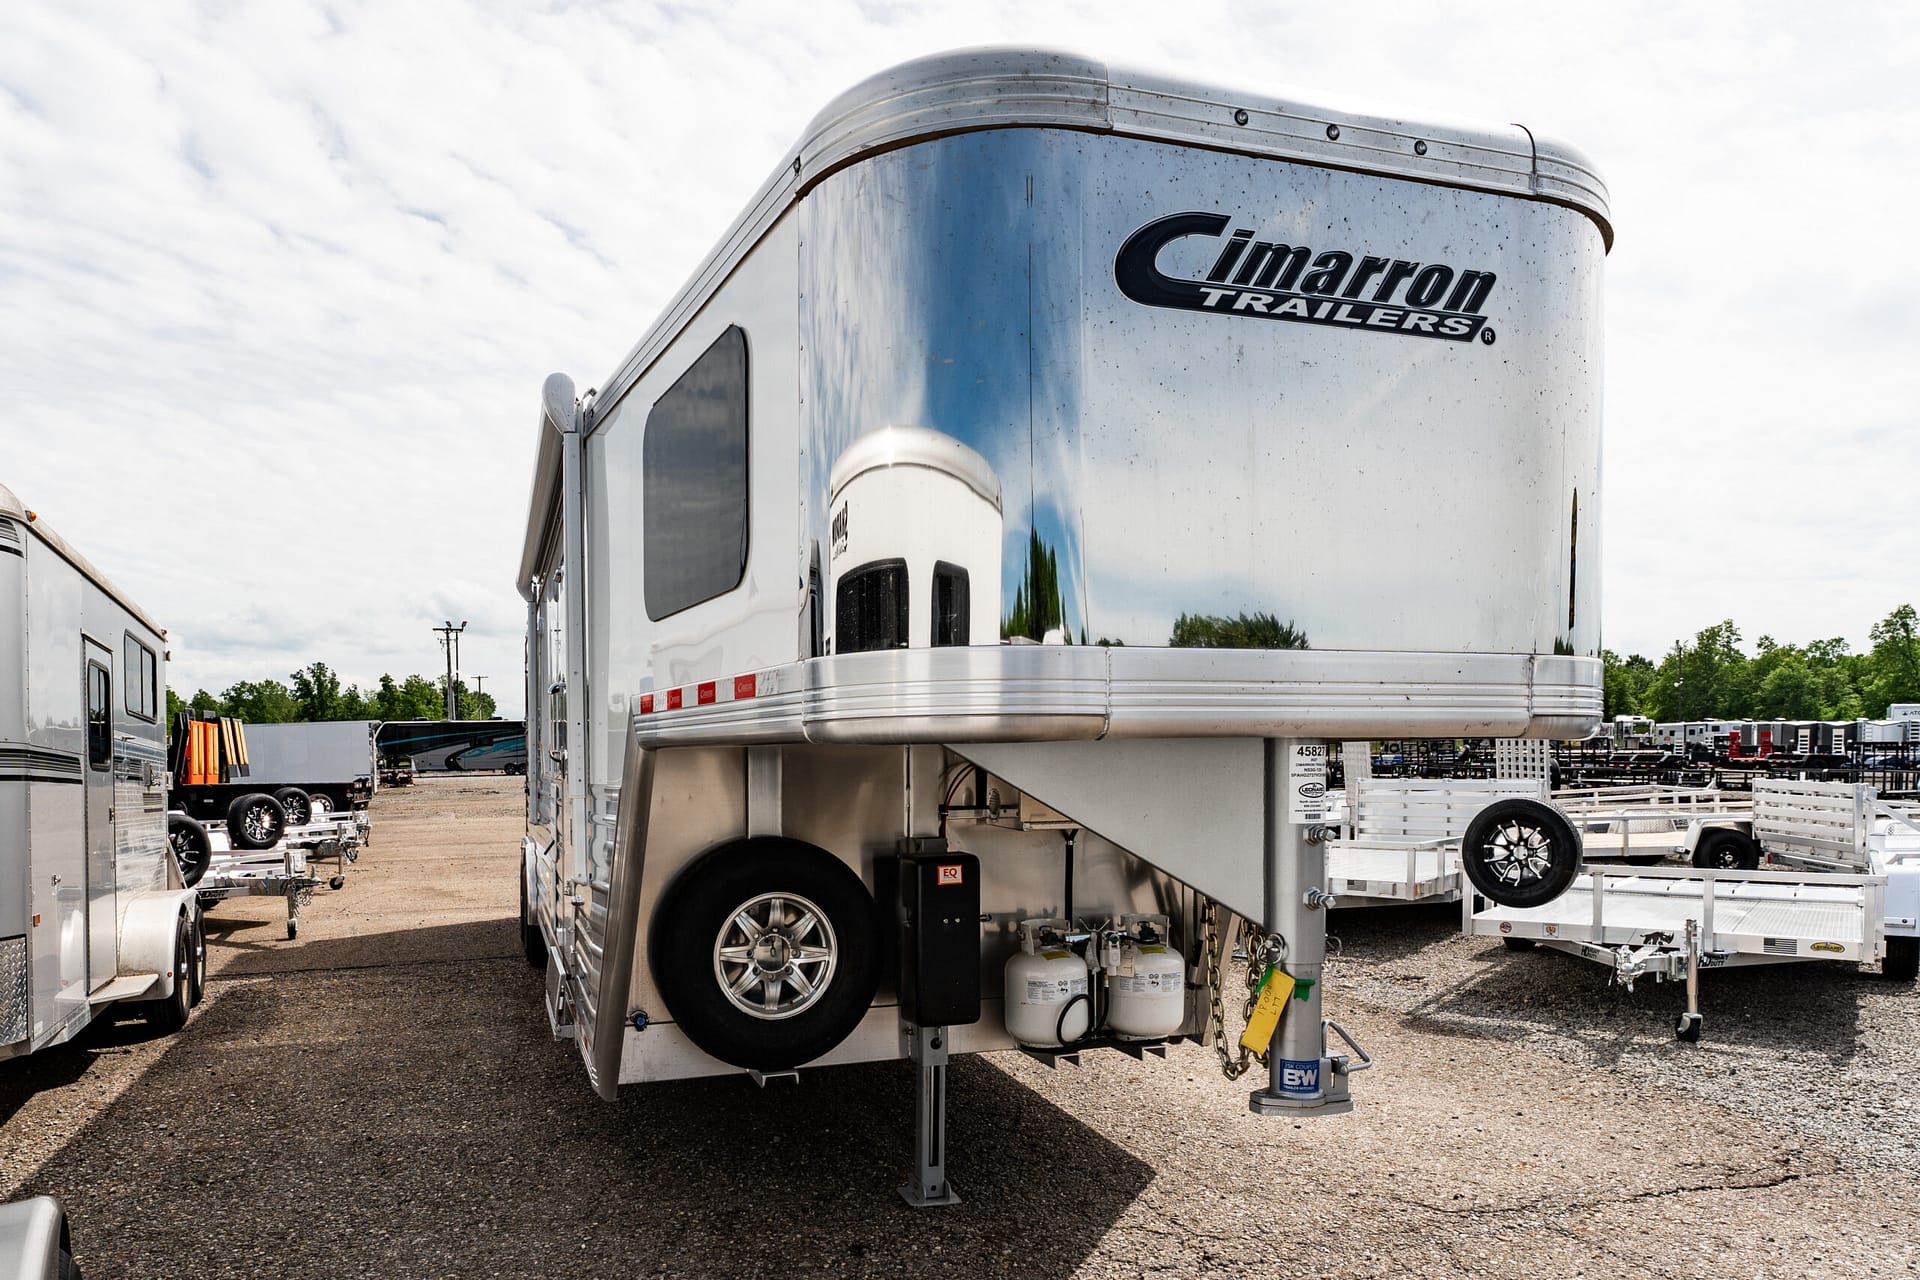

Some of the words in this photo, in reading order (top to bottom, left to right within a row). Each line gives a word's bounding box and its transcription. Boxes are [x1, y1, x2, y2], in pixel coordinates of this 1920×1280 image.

[1114, 211, 1497, 315] Cimarron
[1200, 287, 1473, 336] TRAILERS
[1297, 746, 1326, 756] 45827
[943, 868, 958, 879] EQ
